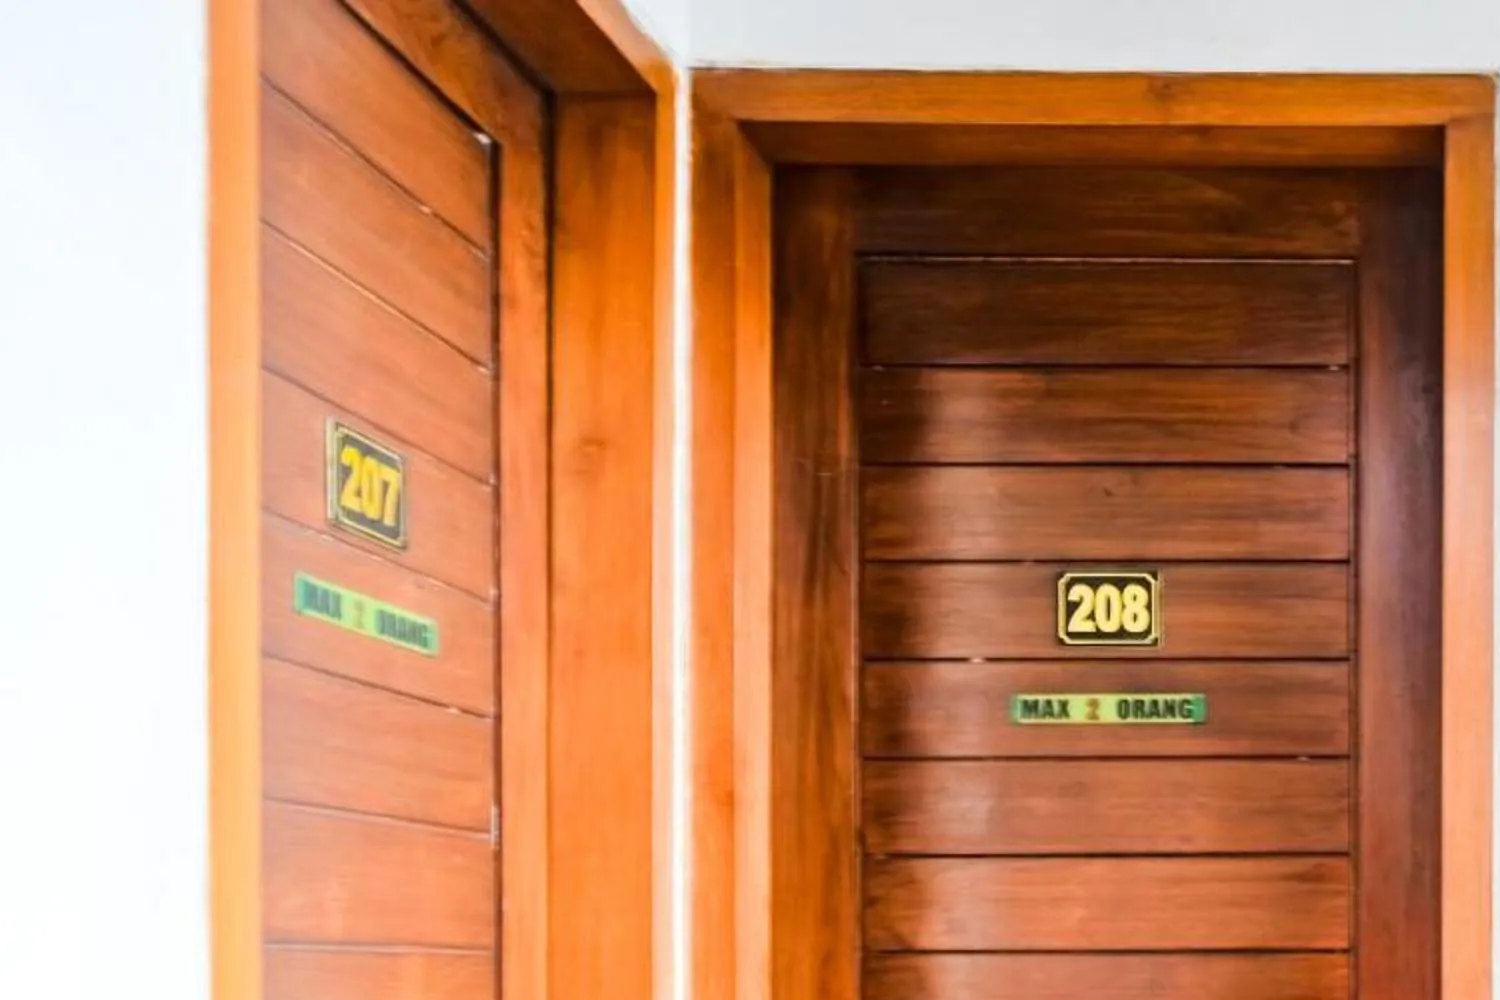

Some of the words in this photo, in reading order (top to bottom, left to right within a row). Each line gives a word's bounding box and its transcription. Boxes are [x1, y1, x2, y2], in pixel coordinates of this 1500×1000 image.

[340, 444, 401, 527] 207
[1067, 583, 1151, 633] 208
[1019, 698, 1070, 719] MAX
[1085, 698, 1100, 720] 2
[1116, 698, 1193, 719] ORANG
